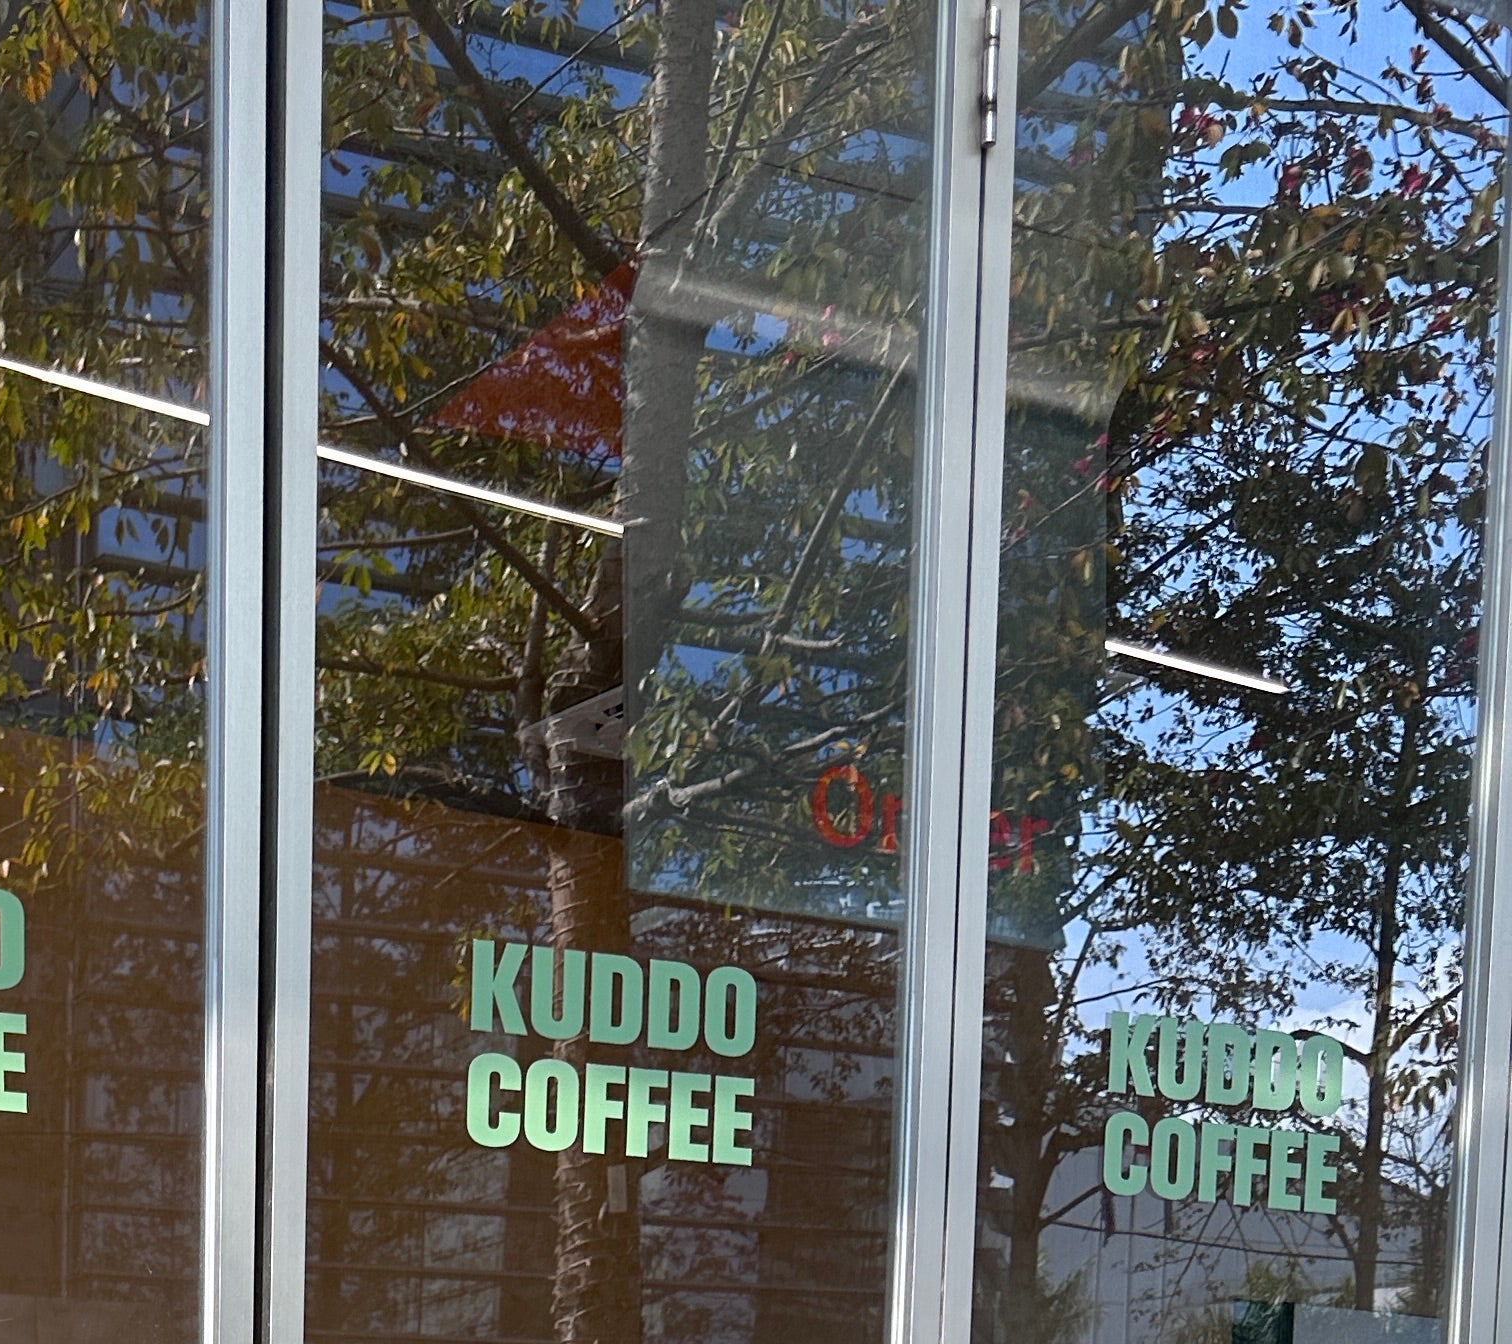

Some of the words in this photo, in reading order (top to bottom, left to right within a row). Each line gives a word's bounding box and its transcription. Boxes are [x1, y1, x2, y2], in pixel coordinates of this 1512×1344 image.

[470, 937, 758, 1058] KUDDO
[466, 1053, 755, 1166] COFFEE
[1106, 1010, 1343, 1116] KUDDO
[1102, 1112, 1340, 1215] COFFEE
